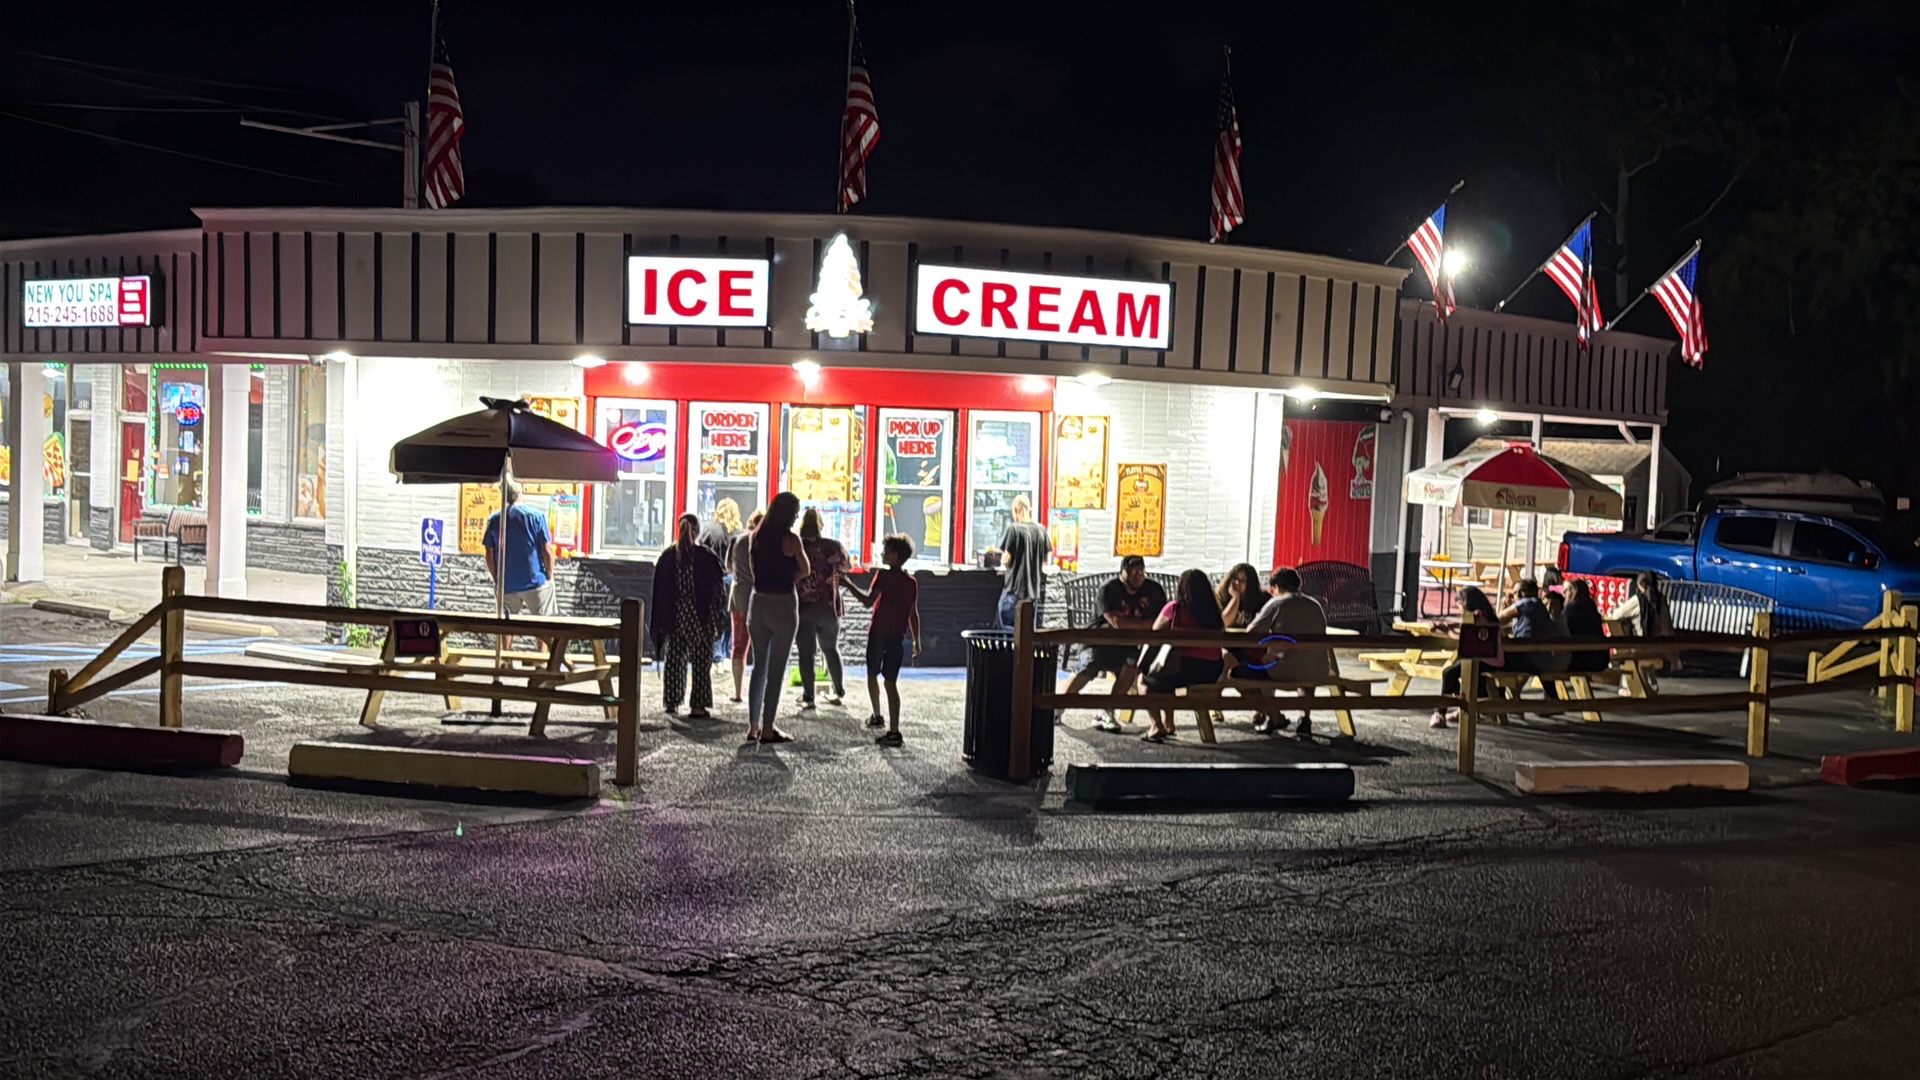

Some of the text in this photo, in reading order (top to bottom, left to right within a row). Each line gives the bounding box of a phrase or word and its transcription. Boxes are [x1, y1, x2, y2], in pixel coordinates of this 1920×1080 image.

[26, 284, 54, 303] NEW
[59, 283, 84, 303] YOU
[89, 282, 113, 302] SPA
[644, 268, 755, 318] ICE
[27, 305, 115, 323] 215-245-1688
[932, 278, 1161, 340] CREAM
[175, 407, 201, 420] OPEN
[704, 412, 755, 428] ORDER
[889, 420, 941, 436] PICK UP
[711, 433, 748, 447] HERE
[898, 440, 935, 455] HERE
